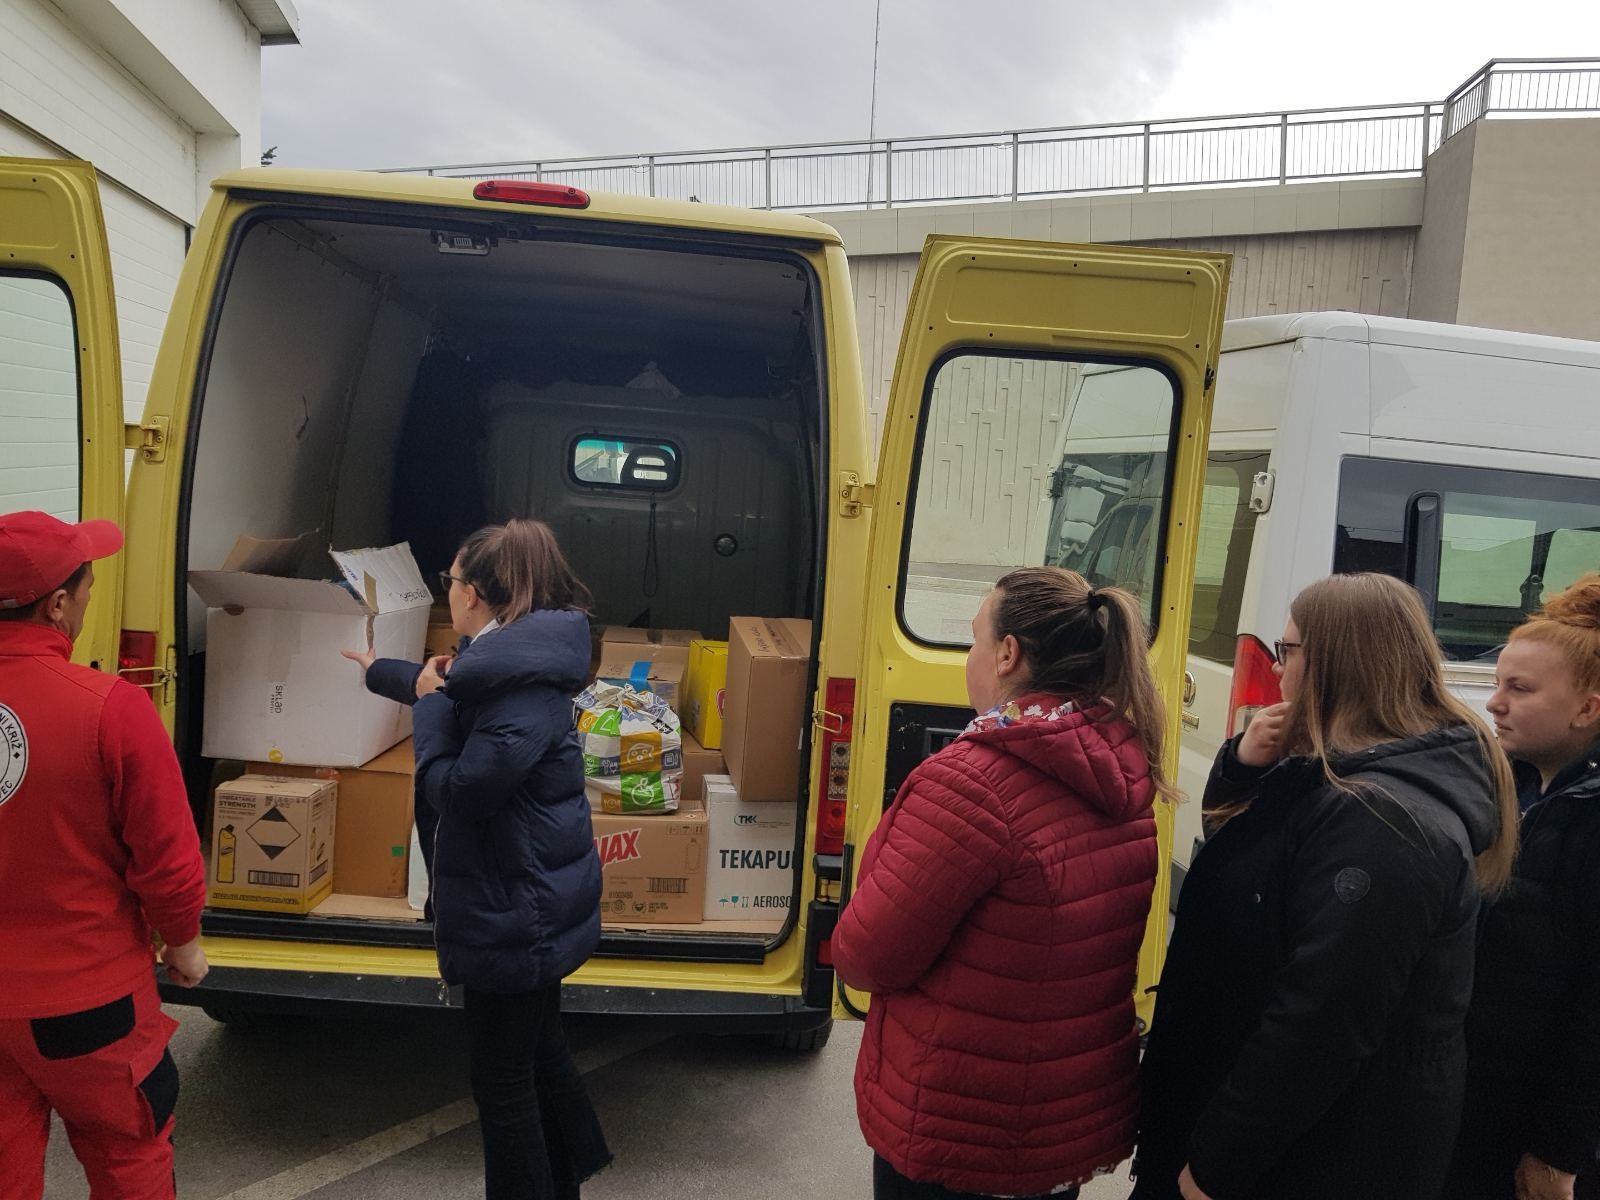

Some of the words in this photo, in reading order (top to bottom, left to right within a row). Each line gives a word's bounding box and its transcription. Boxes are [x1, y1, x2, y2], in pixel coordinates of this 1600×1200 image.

[5, 723, 22, 750] KRIŽ
[0, 780, 13, 799] EC
[219, 800, 257, 809] STRENGTH
[738, 815, 758, 825] TKK
[593, 828, 642, 872] JAX
[719, 849, 796, 870] TEKAPU
